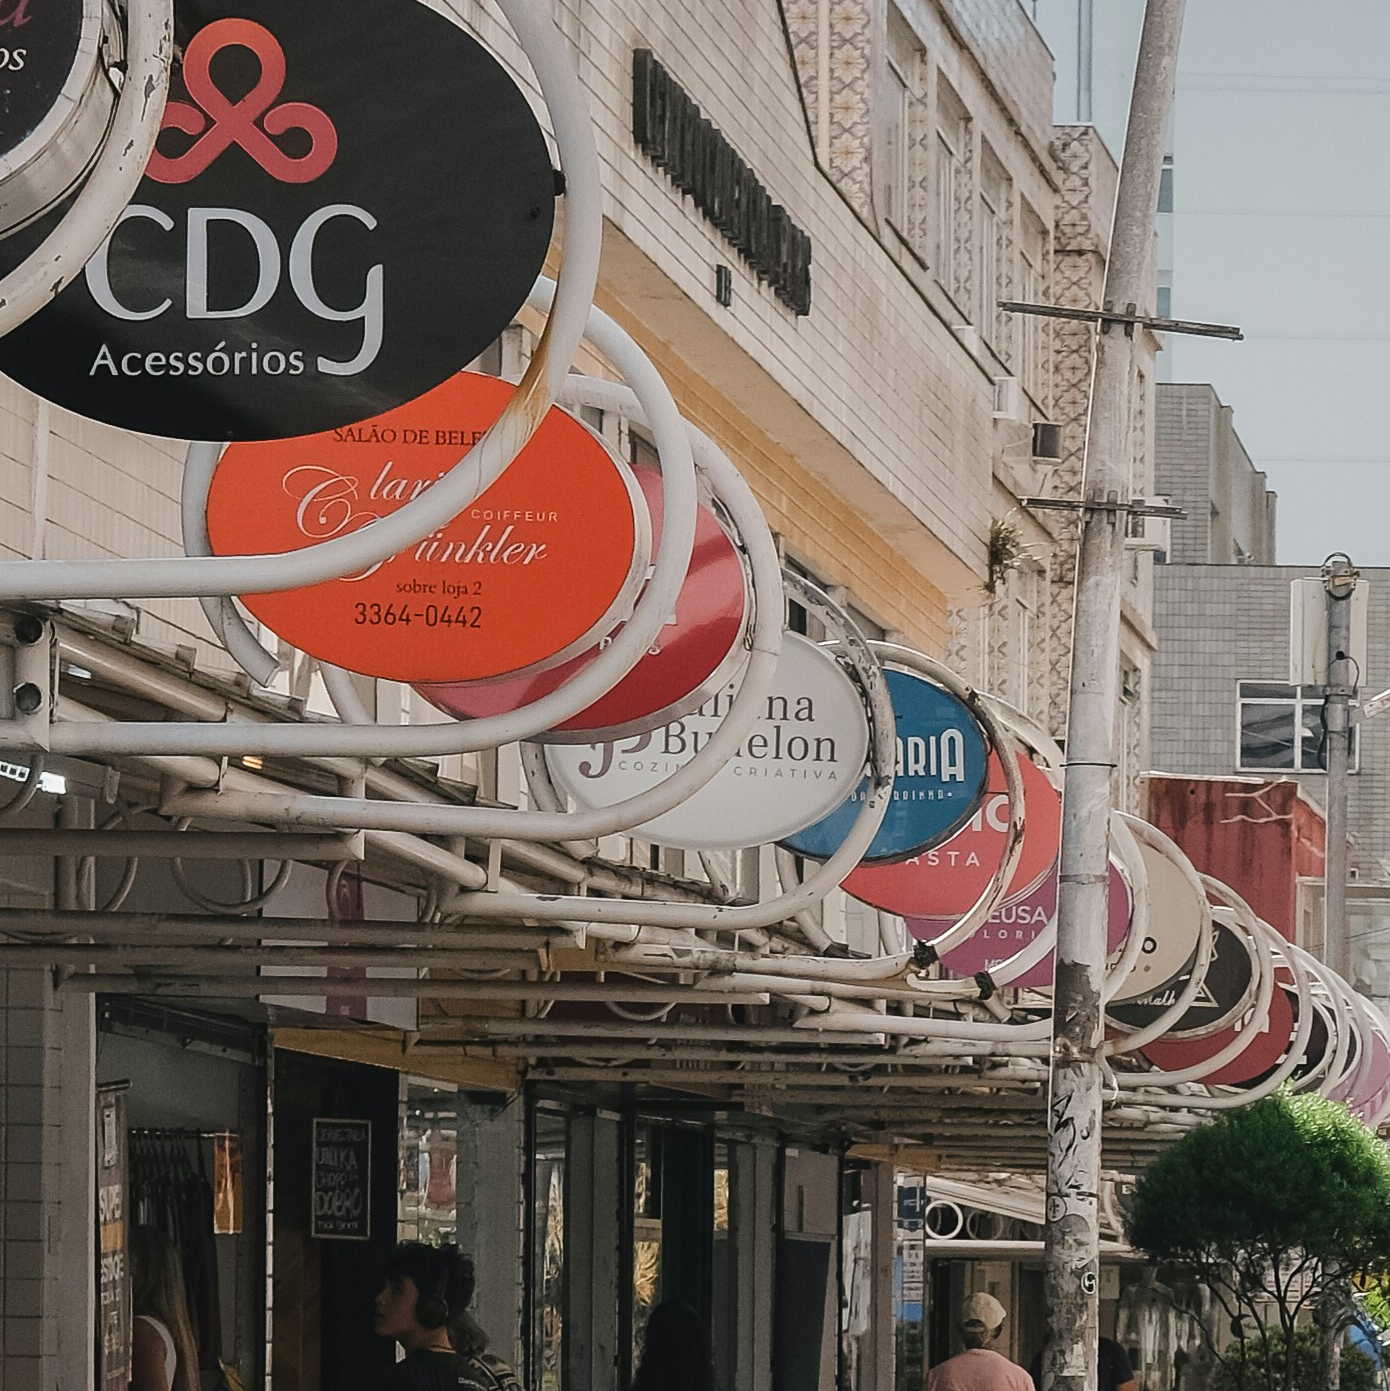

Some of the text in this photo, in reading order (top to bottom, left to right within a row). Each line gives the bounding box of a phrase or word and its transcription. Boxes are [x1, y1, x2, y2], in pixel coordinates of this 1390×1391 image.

[89, 341, 304, 376] Acessórios
[333, 425, 487, 446] SALÃO DE BELE
[470, 509, 558, 522] COIFFEUR
[396, 579, 483, 600] sobre loja 2
[354, 603, 483, 629] 3364-0442
[660, 720, 838, 762] Buelon
[733, 766, 838, 780] CRIATIVA
[987, 904, 1049, 925] EUSA
